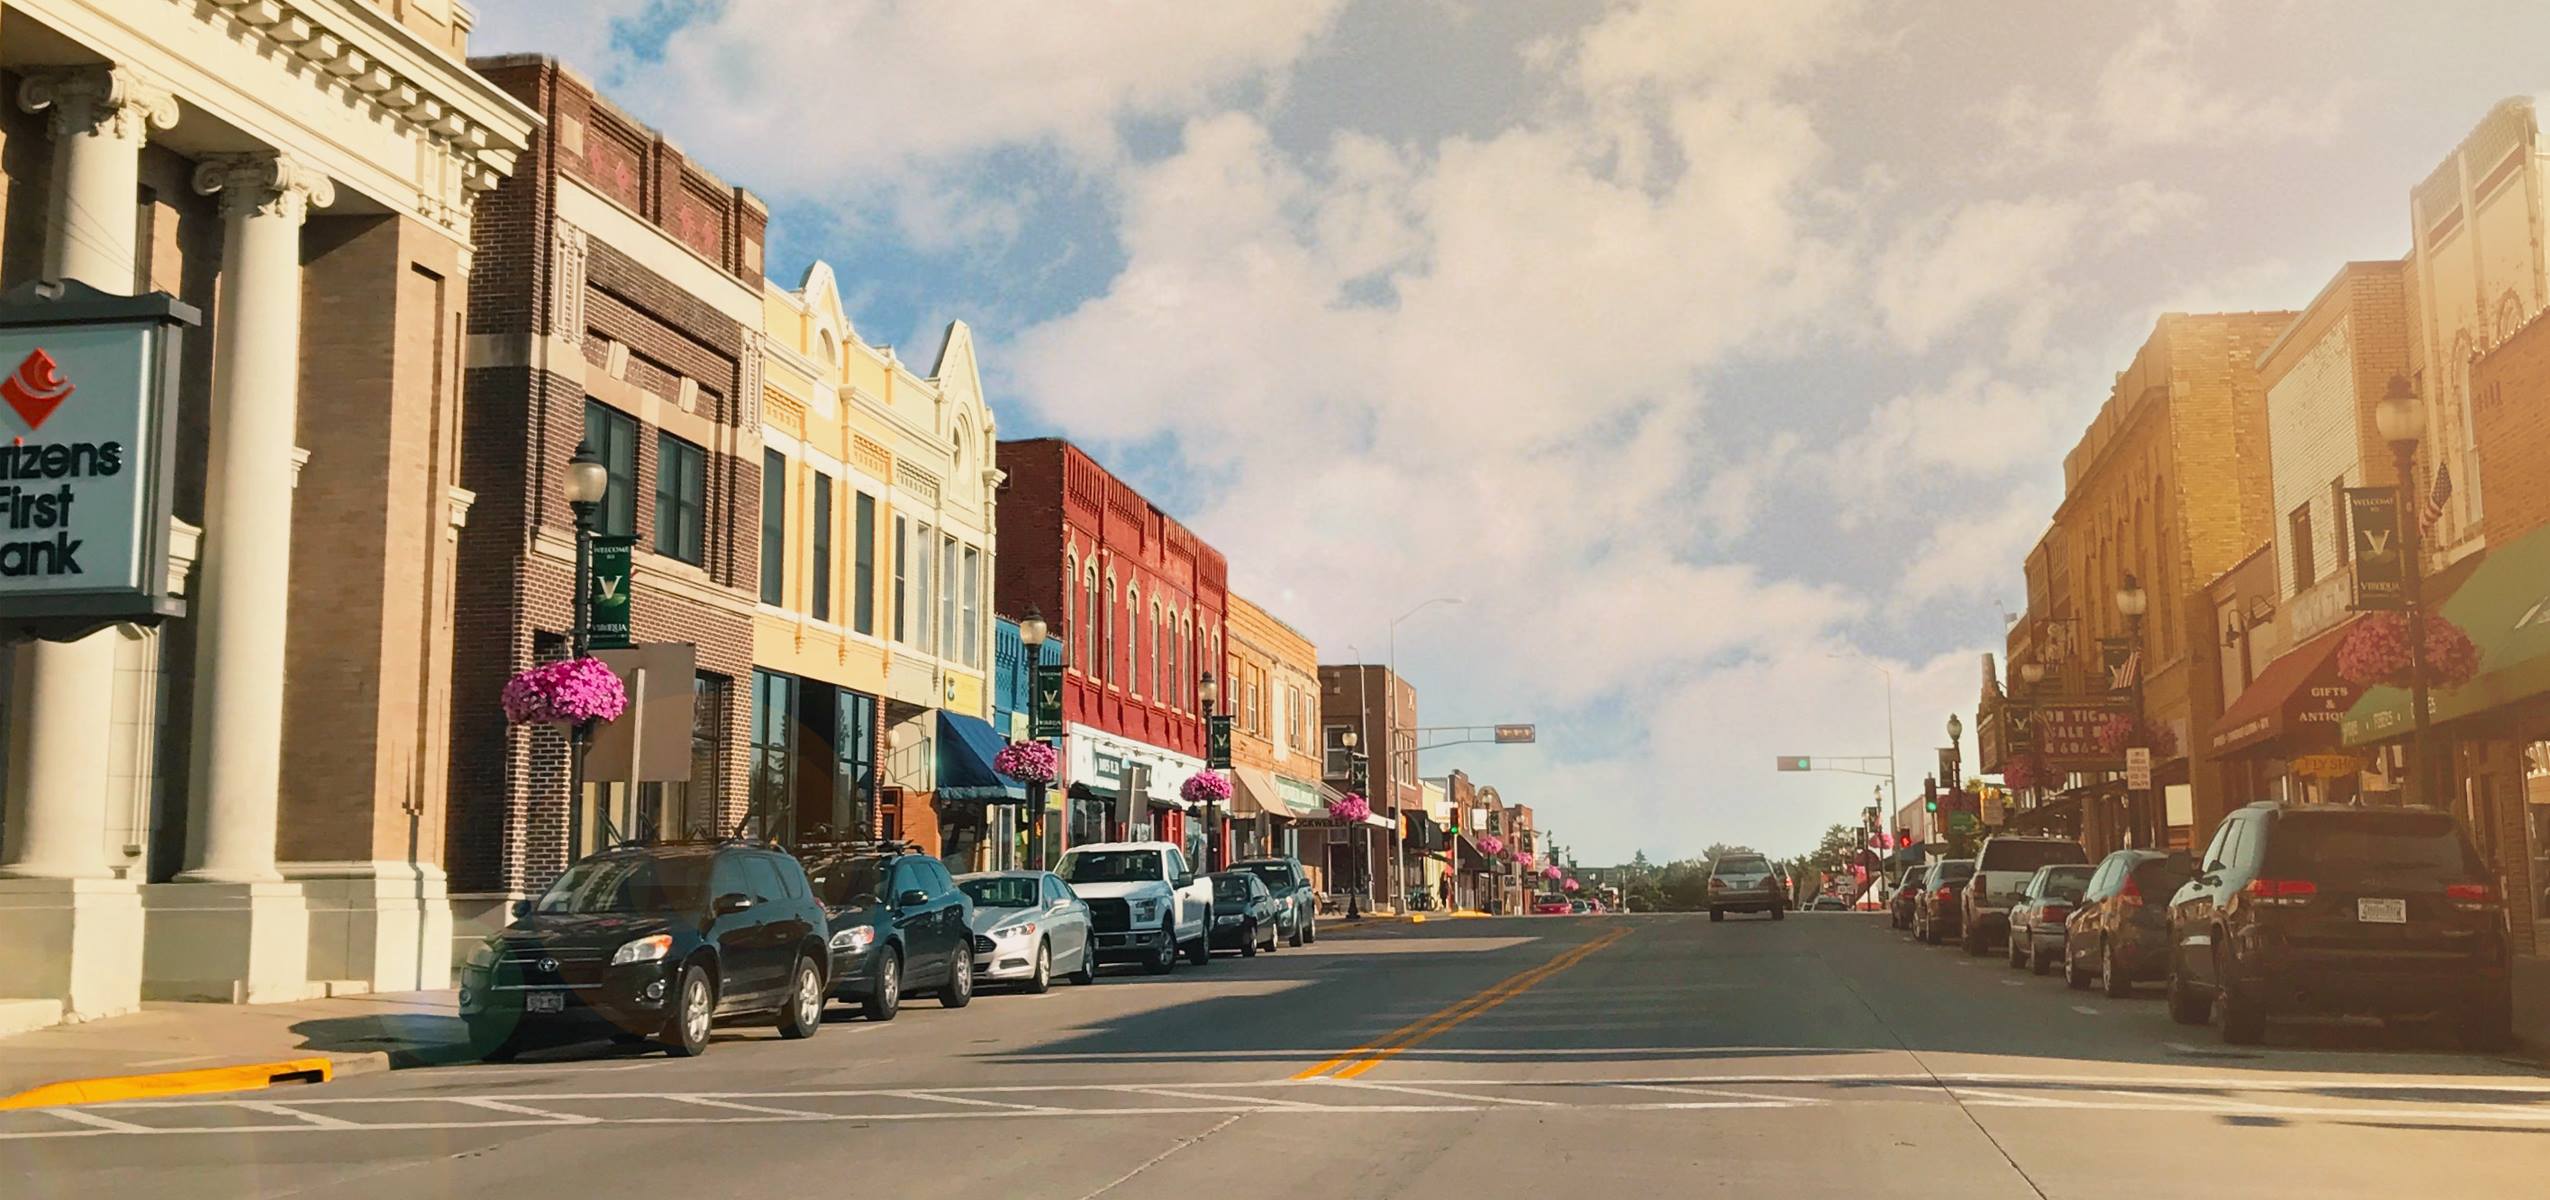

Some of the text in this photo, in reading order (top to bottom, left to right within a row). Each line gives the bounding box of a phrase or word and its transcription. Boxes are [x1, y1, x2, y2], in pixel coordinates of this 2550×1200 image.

[2362, 529, 2391, 556] V
[0, 531, 84, 577] ank
[596, 575, 623, 600] V
[2311, 686, 2349, 697] GIFTS
[2325, 699, 2336, 709] &
[2299, 711, 2345, 722] ANTIQ
